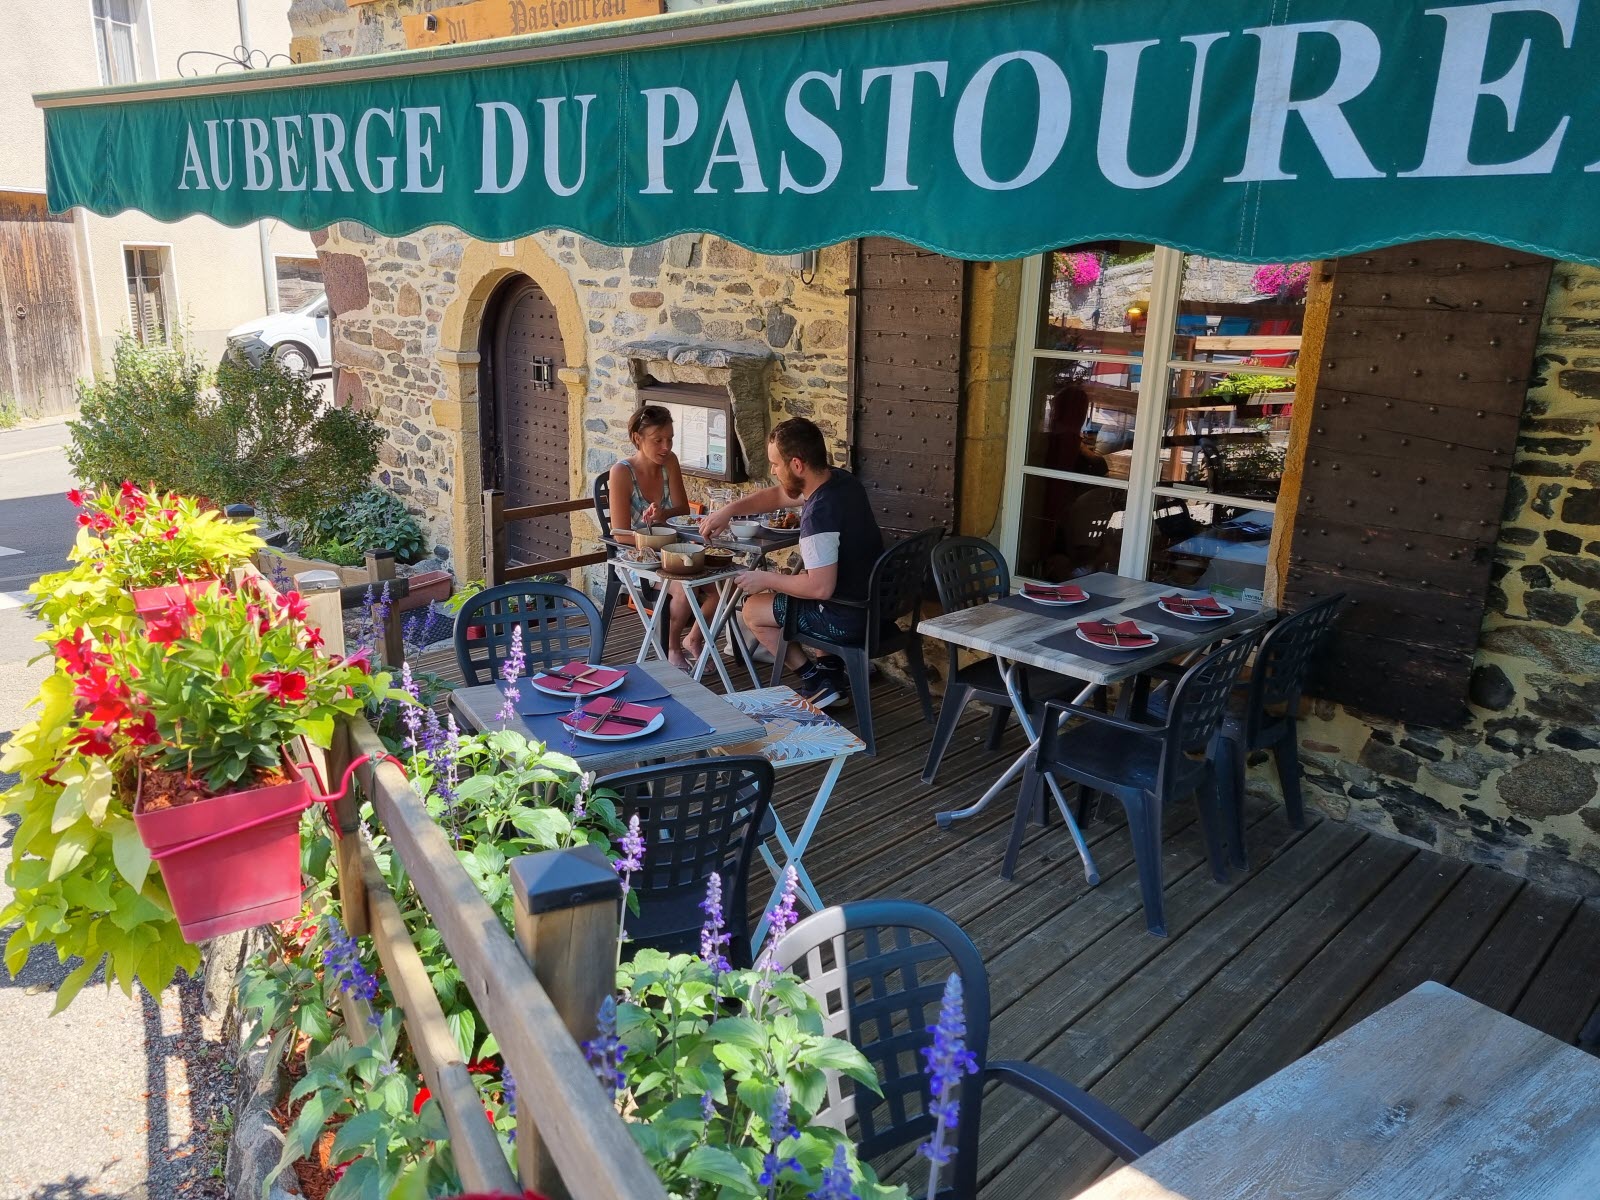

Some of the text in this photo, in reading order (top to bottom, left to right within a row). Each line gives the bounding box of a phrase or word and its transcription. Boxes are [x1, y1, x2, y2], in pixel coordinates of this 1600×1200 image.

[446, 0, 627, 42] du Pastoureau
[177, 0, 1600, 196] AUBERGE DU PASTOURE
